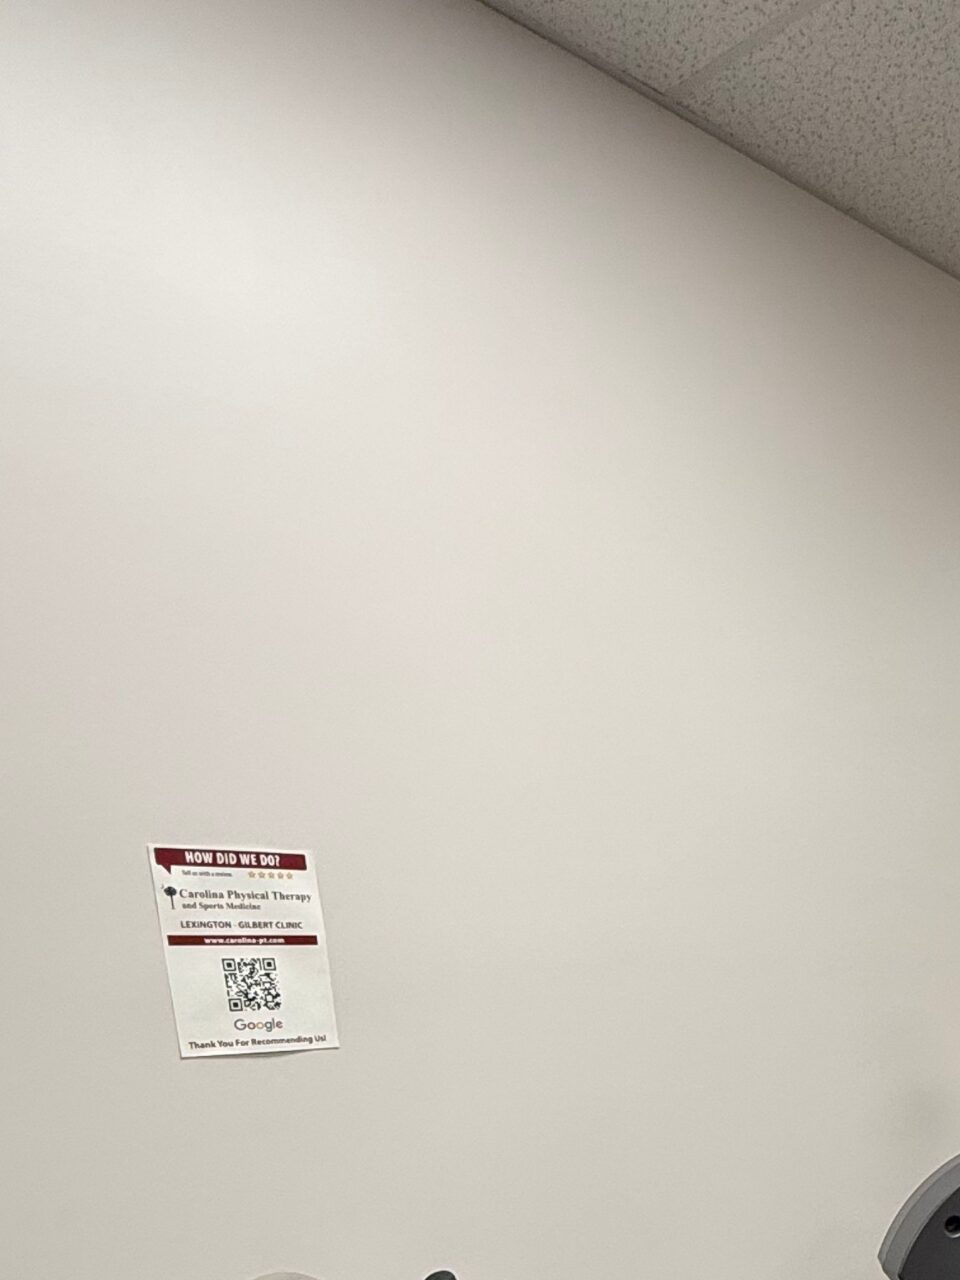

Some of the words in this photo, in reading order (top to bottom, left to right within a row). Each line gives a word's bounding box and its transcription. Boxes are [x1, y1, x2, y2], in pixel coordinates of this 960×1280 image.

[184, 851, 213, 863] HOW
[216, 852, 237, 864] DID
[239, 853, 257, 865] WE
[259, 854, 280, 867] DO?
[179, 888, 224, 899] Carolina
[227, 890, 269, 902] Physical
[271, 891, 312, 903] Therapy
[198, 902, 224, 911] Sports
[180, 920, 232, 929] LEXINGTON
[238, 920, 273, 929] GILBERT
[275, 921, 303, 930] CLINIC
[204, 936, 285, 944] www.carolina-pt.com
[234, 1017, 283, 1033] Google
[188, 1041, 217, 1049] Thank
[217, 1040, 234, 1048] You
[235, 1039, 249, 1047] For
[251, 1035, 313, 1046] Recommending
[314, 1034, 327, 1042] Us!
